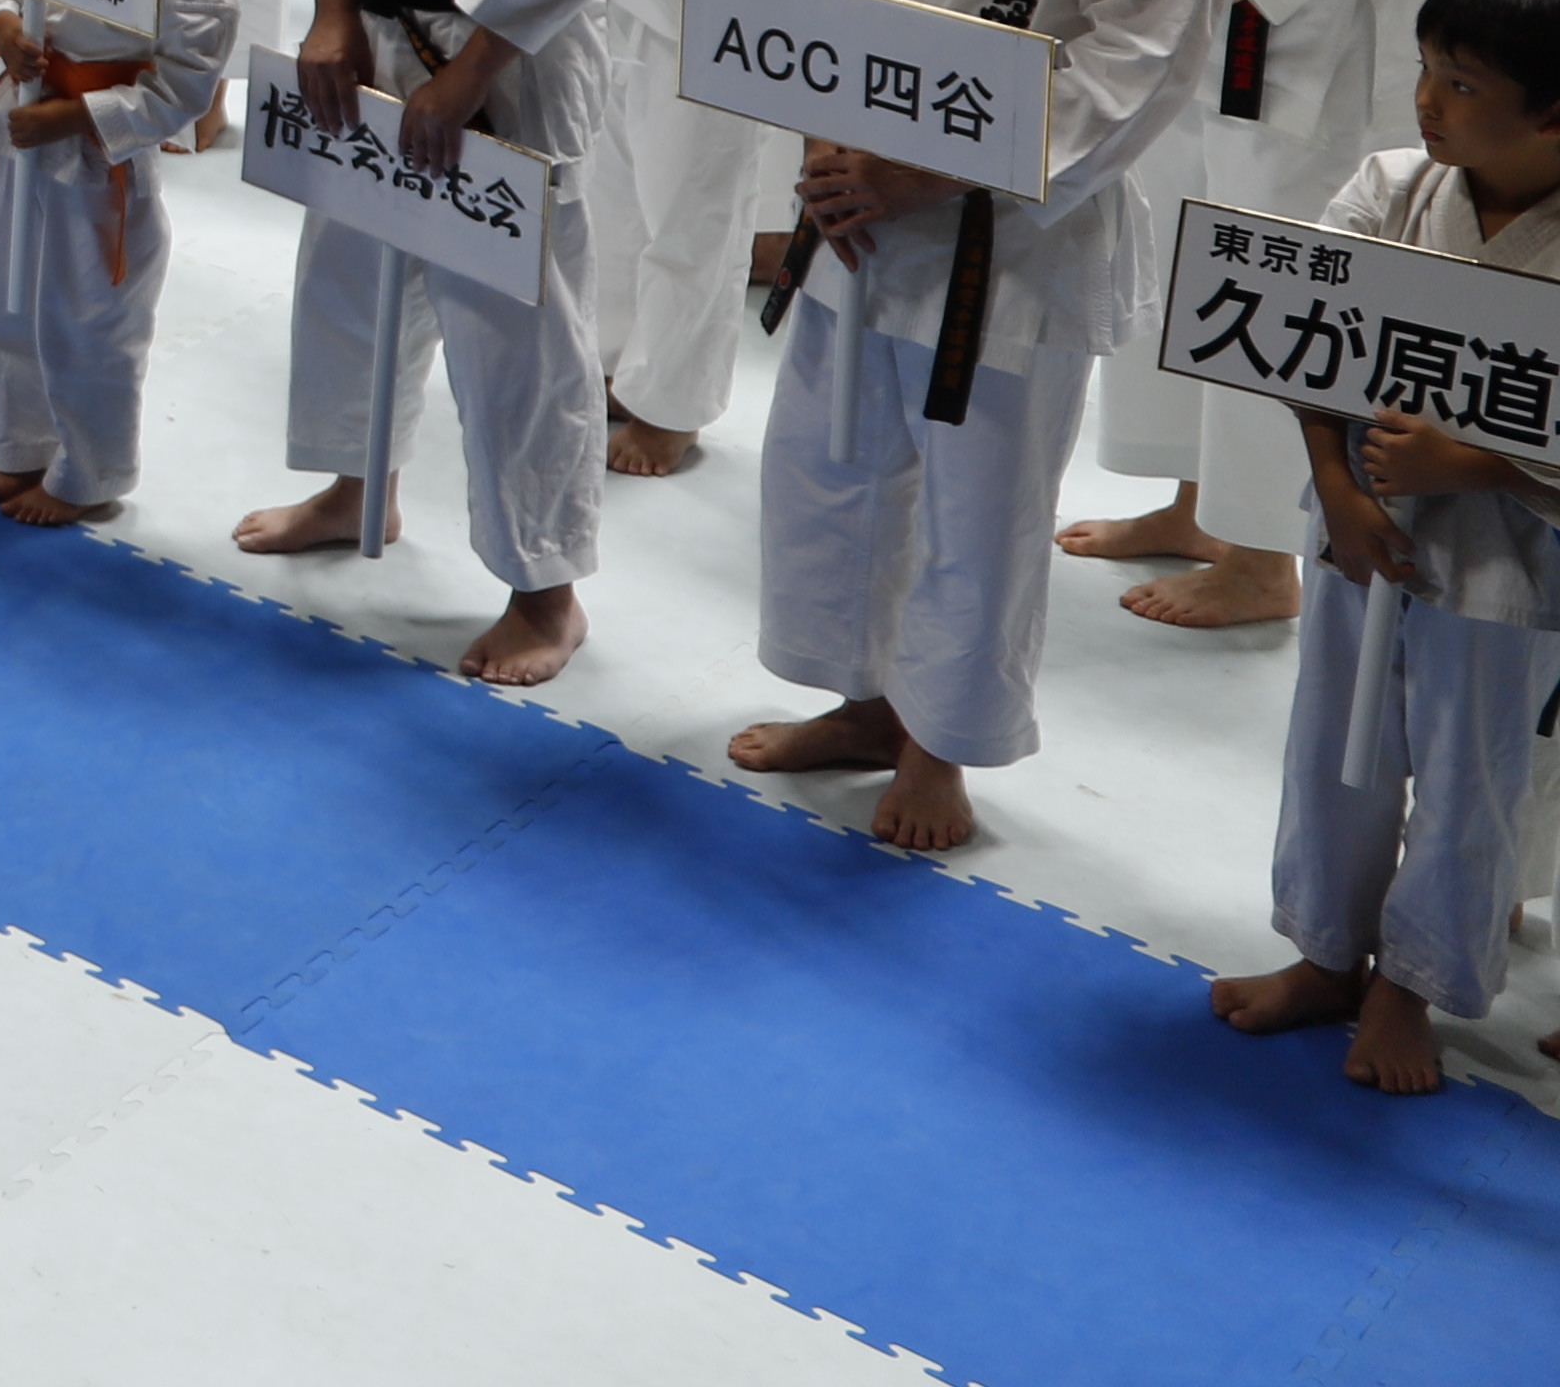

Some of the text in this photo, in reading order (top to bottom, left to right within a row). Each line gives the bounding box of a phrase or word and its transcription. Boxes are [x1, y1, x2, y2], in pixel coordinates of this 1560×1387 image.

[713, 17, 997, 144] ACC 四谷
[1209, 221, 1353, 287] 東京都
[1190, 277, 1560, 449] 久が原道
